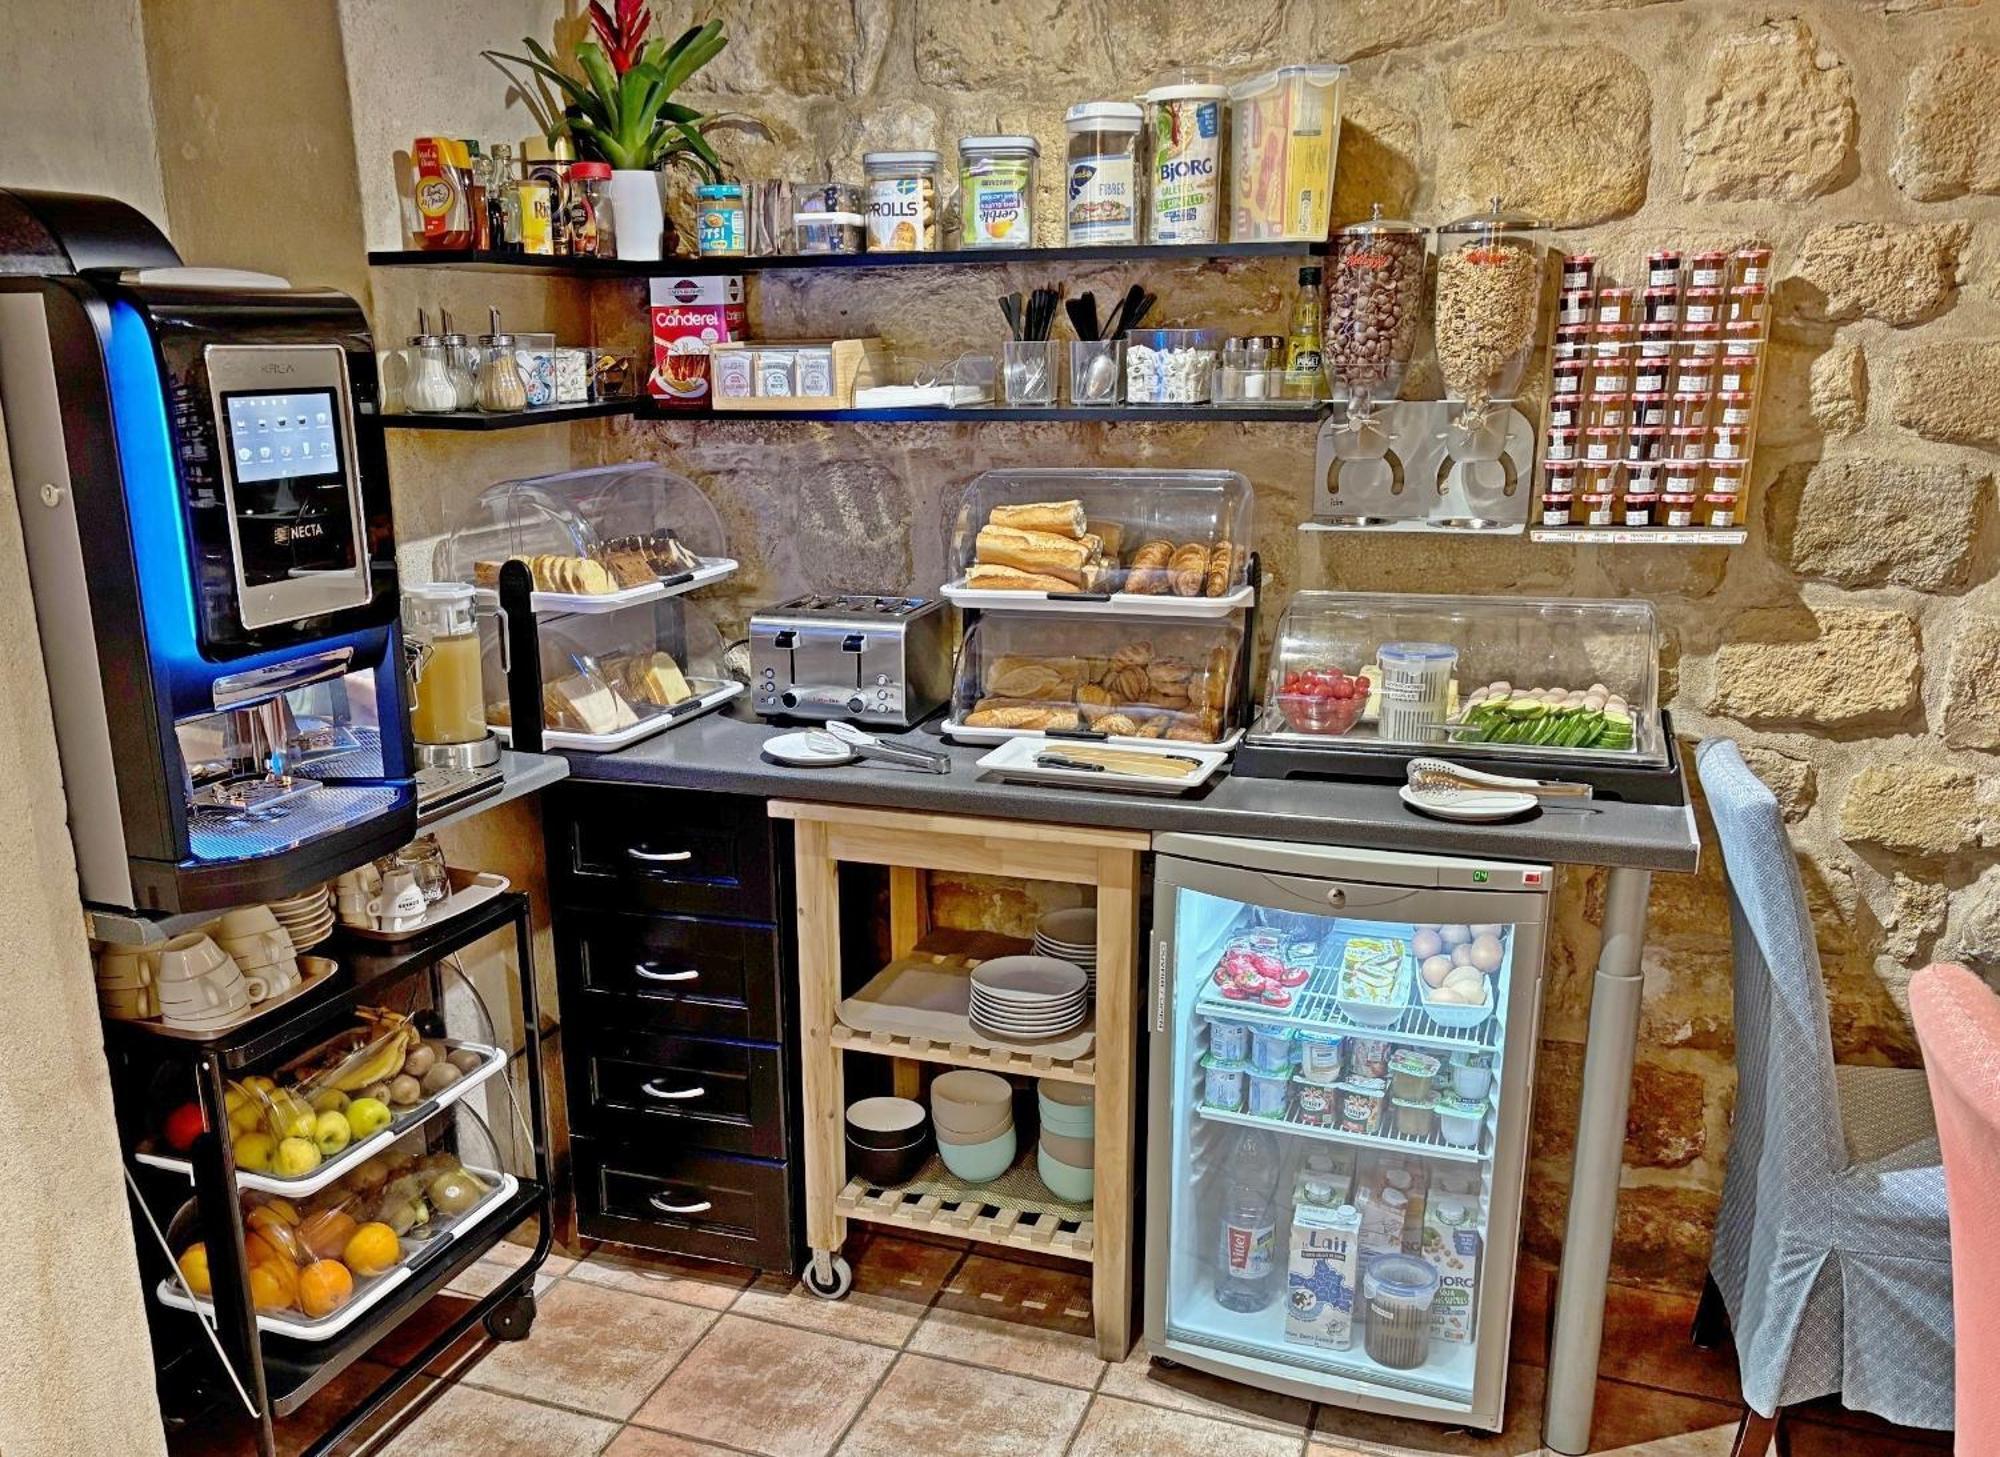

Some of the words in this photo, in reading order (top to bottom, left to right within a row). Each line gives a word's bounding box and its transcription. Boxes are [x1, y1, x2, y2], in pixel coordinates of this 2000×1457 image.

[1099, 182, 1125, 195] FIBRES
[656, 310, 719, 327] Canderel
[290, 523, 324, 539] NECTA
[1309, 1231, 1347, 1253] Lait
[1440, 1276, 1474, 1288] jORG
